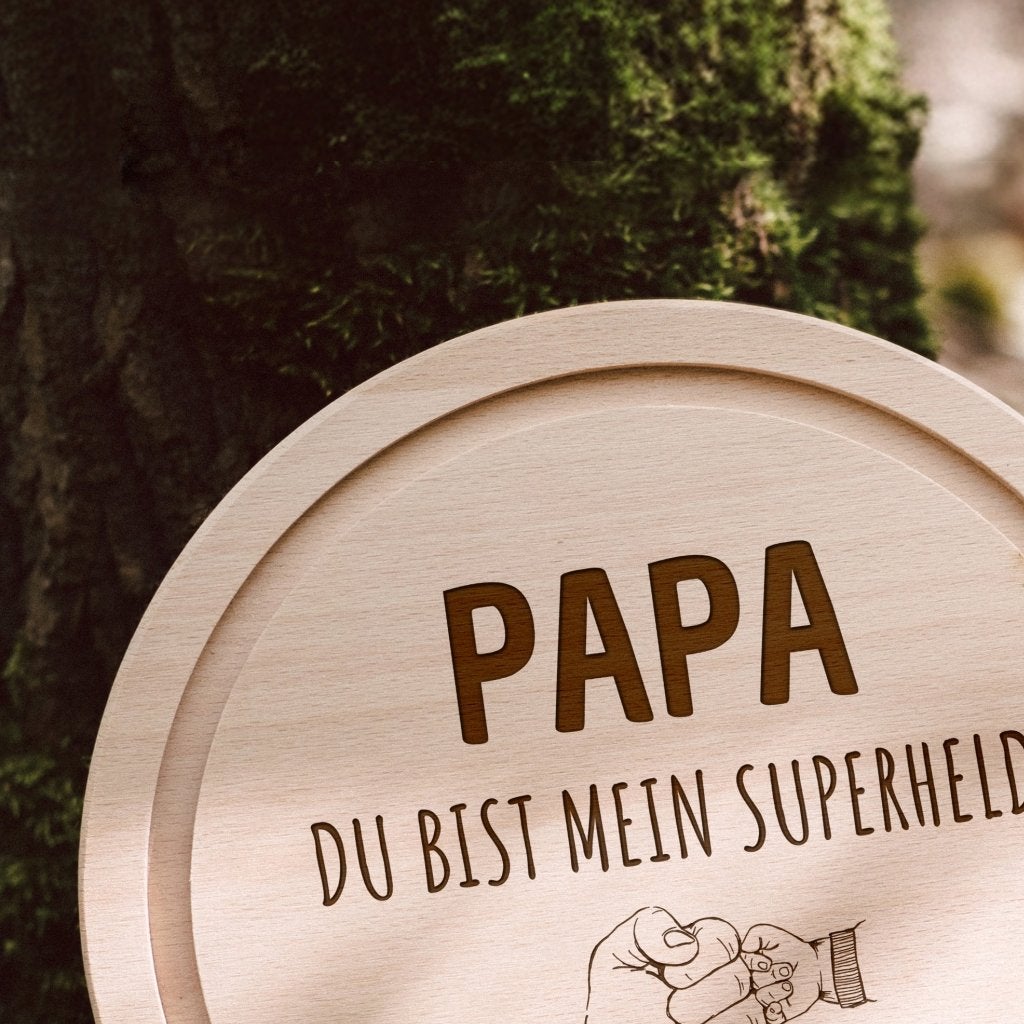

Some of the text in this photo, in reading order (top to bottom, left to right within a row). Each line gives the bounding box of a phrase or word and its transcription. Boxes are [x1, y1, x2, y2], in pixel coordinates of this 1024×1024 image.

[443, 540, 858, 744] PAPA
[310, 814, 393, 906] DU
[418, 794, 536, 893] BIST
[562, 769, 712, 873] MEIN
